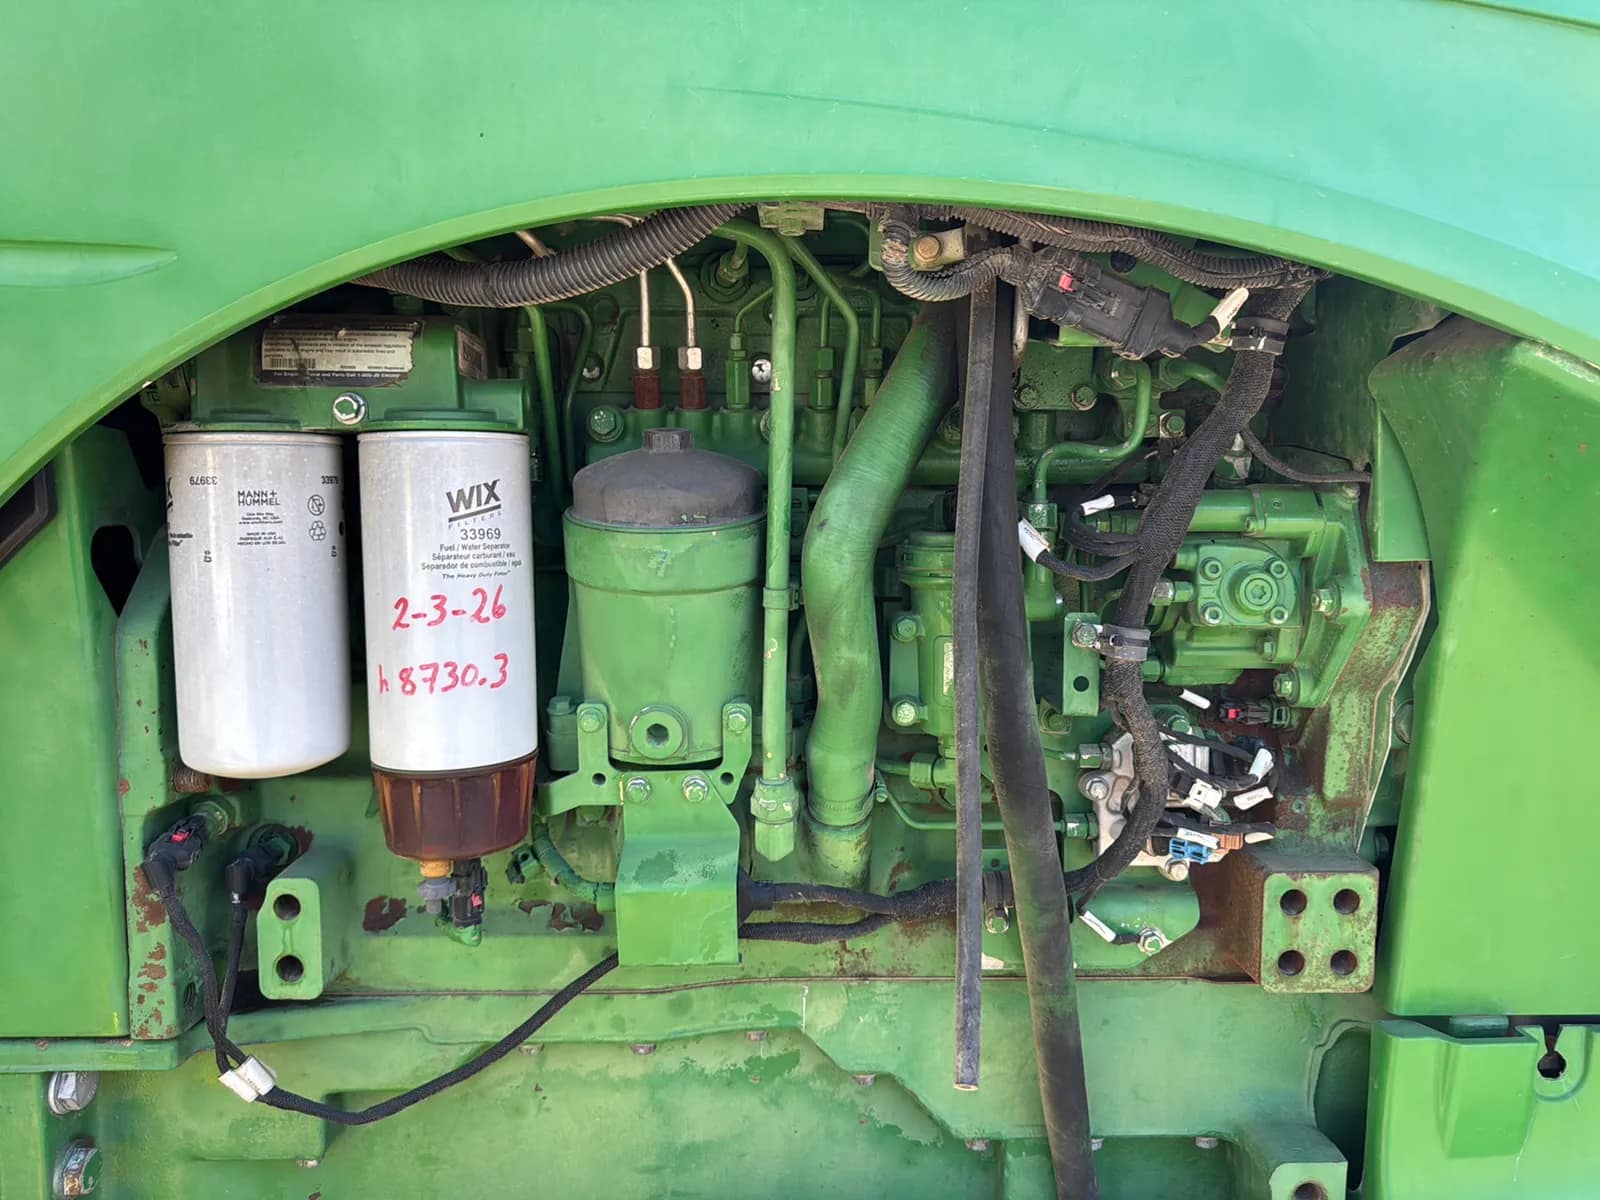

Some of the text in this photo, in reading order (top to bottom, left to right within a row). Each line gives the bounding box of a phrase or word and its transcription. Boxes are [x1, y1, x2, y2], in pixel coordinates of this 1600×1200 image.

[238, 498, 280, 506] HUMMEL
[446, 479, 501, 514] WIX
[460, 528, 502, 540] 33969
[440, 544, 455, 552] Fuel
[482, 542, 510, 552] Separator
[421, 562, 458, 572] Separador
[392, 583, 507, 632] 2-3-26
[398, 652, 509, 696] 8730.3
